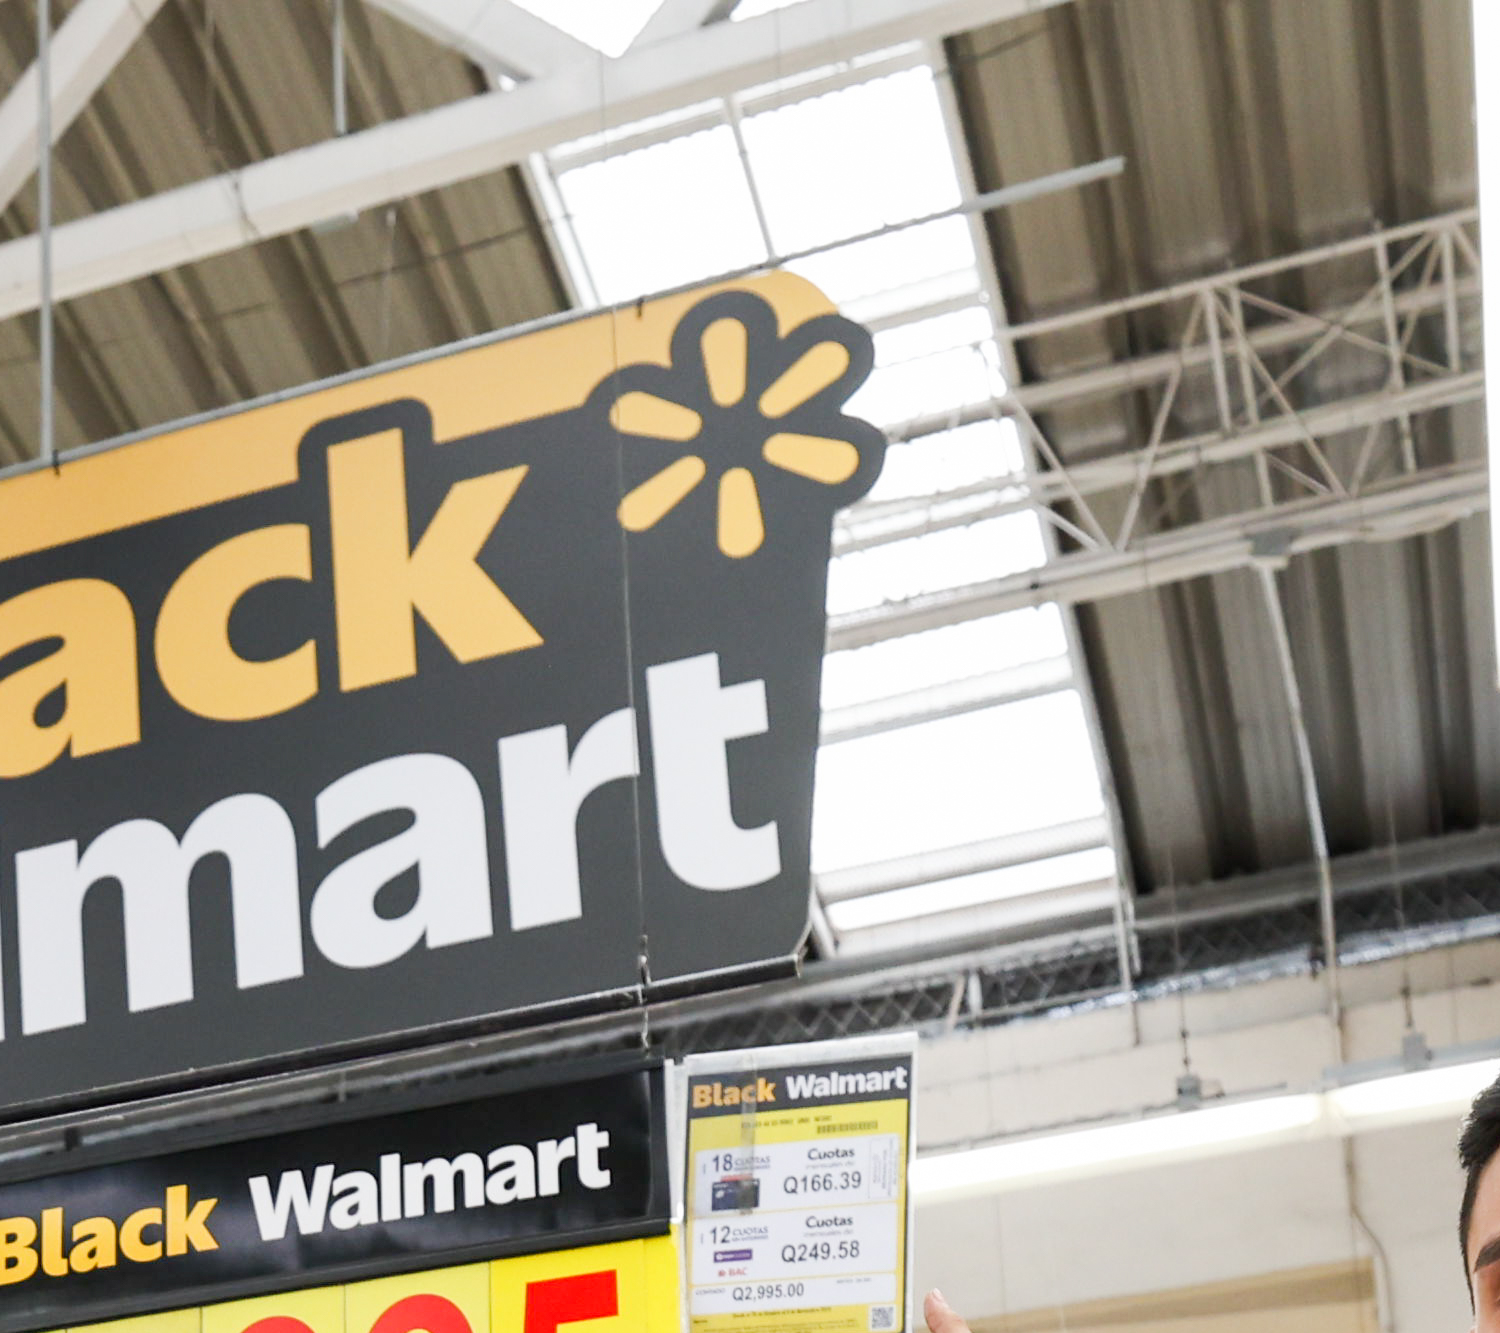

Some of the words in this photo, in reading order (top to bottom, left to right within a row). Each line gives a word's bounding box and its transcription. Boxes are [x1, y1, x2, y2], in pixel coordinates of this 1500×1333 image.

[692, 1077, 775, 1108] Black
[785, 1066, 907, 1099] Walmart
[712, 1154, 732, 1173] 18
[807, 1147, 854, 1161] Cuotas
[249, 1123, 611, 1241] Walmart
[784, 1172, 861, 1194] Q166.39
[806, 1216, 853, 1228] Cuotas
[710, 1226, 730, 1244] 12
[781, 1241, 860, 1263] Q249.58
[732, 1283, 804, 1302] Q2,995.00
